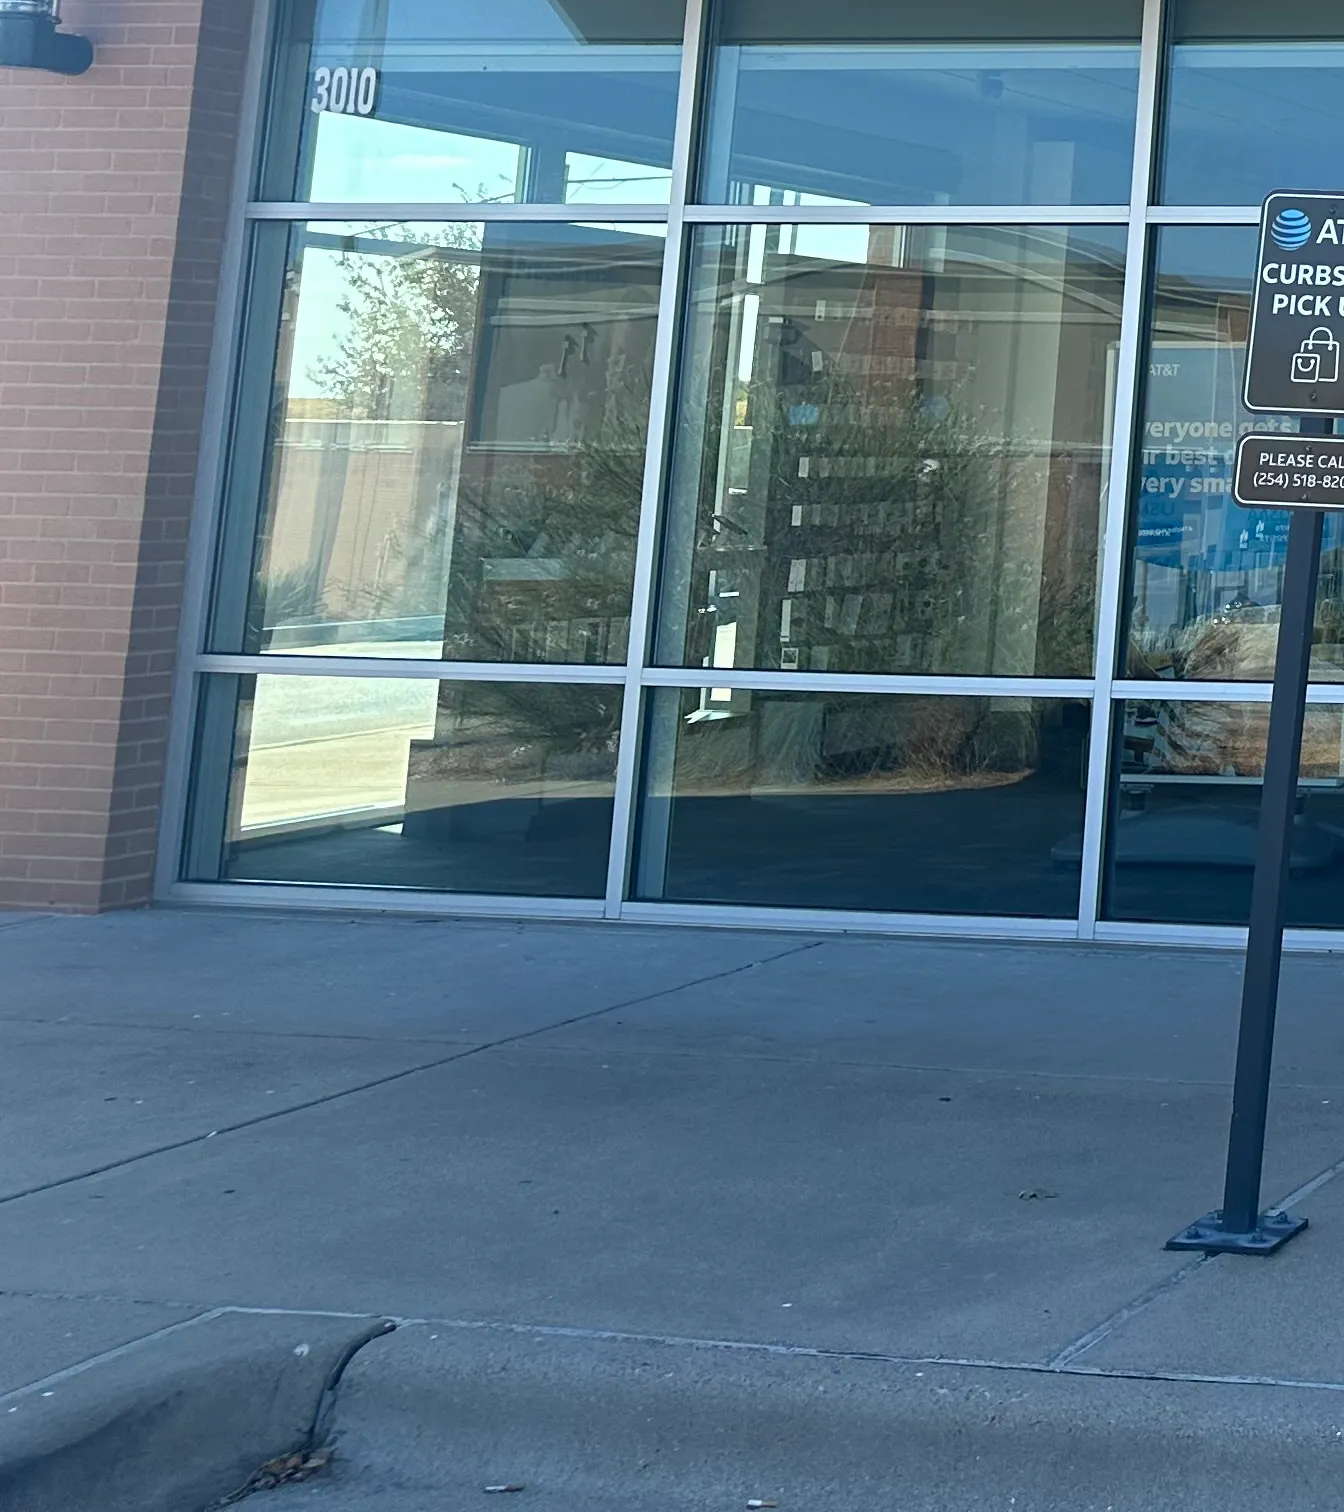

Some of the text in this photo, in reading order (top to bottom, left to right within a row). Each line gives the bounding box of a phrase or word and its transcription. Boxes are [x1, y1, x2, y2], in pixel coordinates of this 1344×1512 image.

[311, 66, 377, 115] 3010
[1272, 294, 1331, 317] PICK
[1166, 445, 1219, 466] best
[1259, 452, 1315, 469] PLEASE
[1253, 471, 1289, 489] (254)
